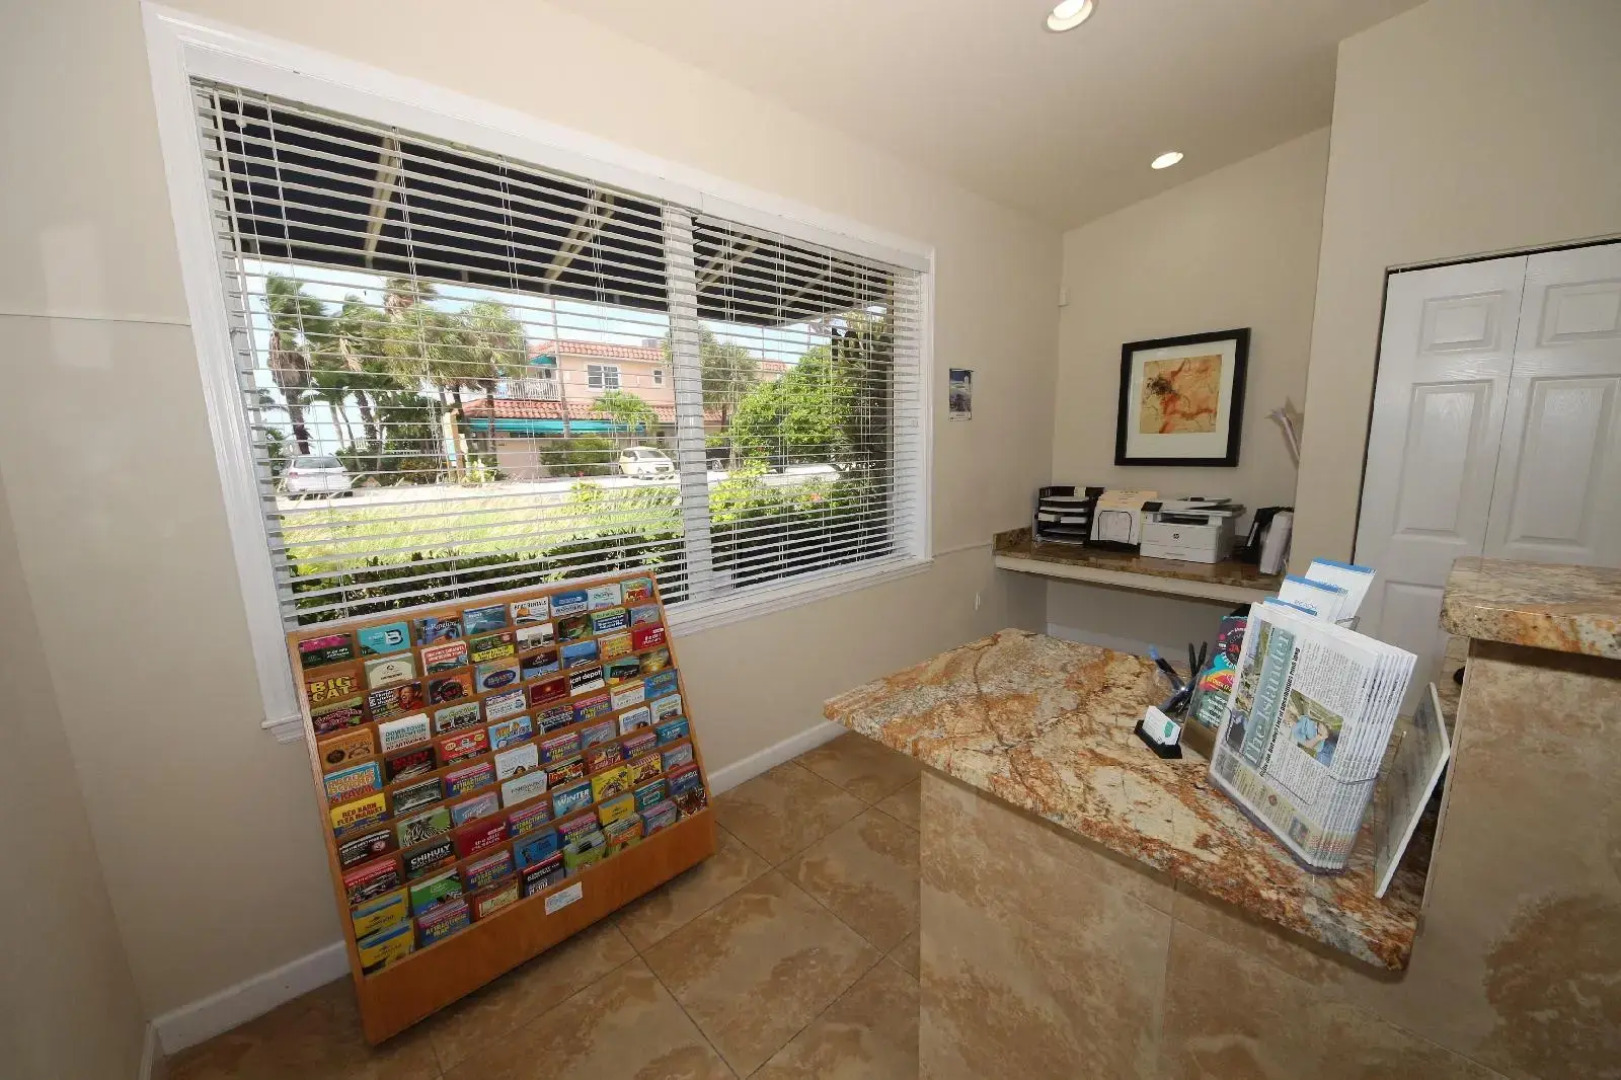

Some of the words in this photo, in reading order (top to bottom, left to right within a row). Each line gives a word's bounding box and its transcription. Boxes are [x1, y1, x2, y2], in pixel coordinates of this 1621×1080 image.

[310, 676, 351, 693] BIG
[570, 676, 581, 684] cat
[582, 670, 602, 680] depot
[313, 686, 349, 702] CAT
[1244, 723, 1265, 764] The
[1256, 630, 1290, 722] Islander
[386, 724, 426, 737] DOWNTOWN
[341, 784, 374, 799] KAYAK
[558, 788, 590, 806] WINTER
[337, 816, 354, 826] FLEA
[356, 806, 382, 817] MARKET
[342, 809, 356, 818] RED
[358, 802, 376, 812] BARN
